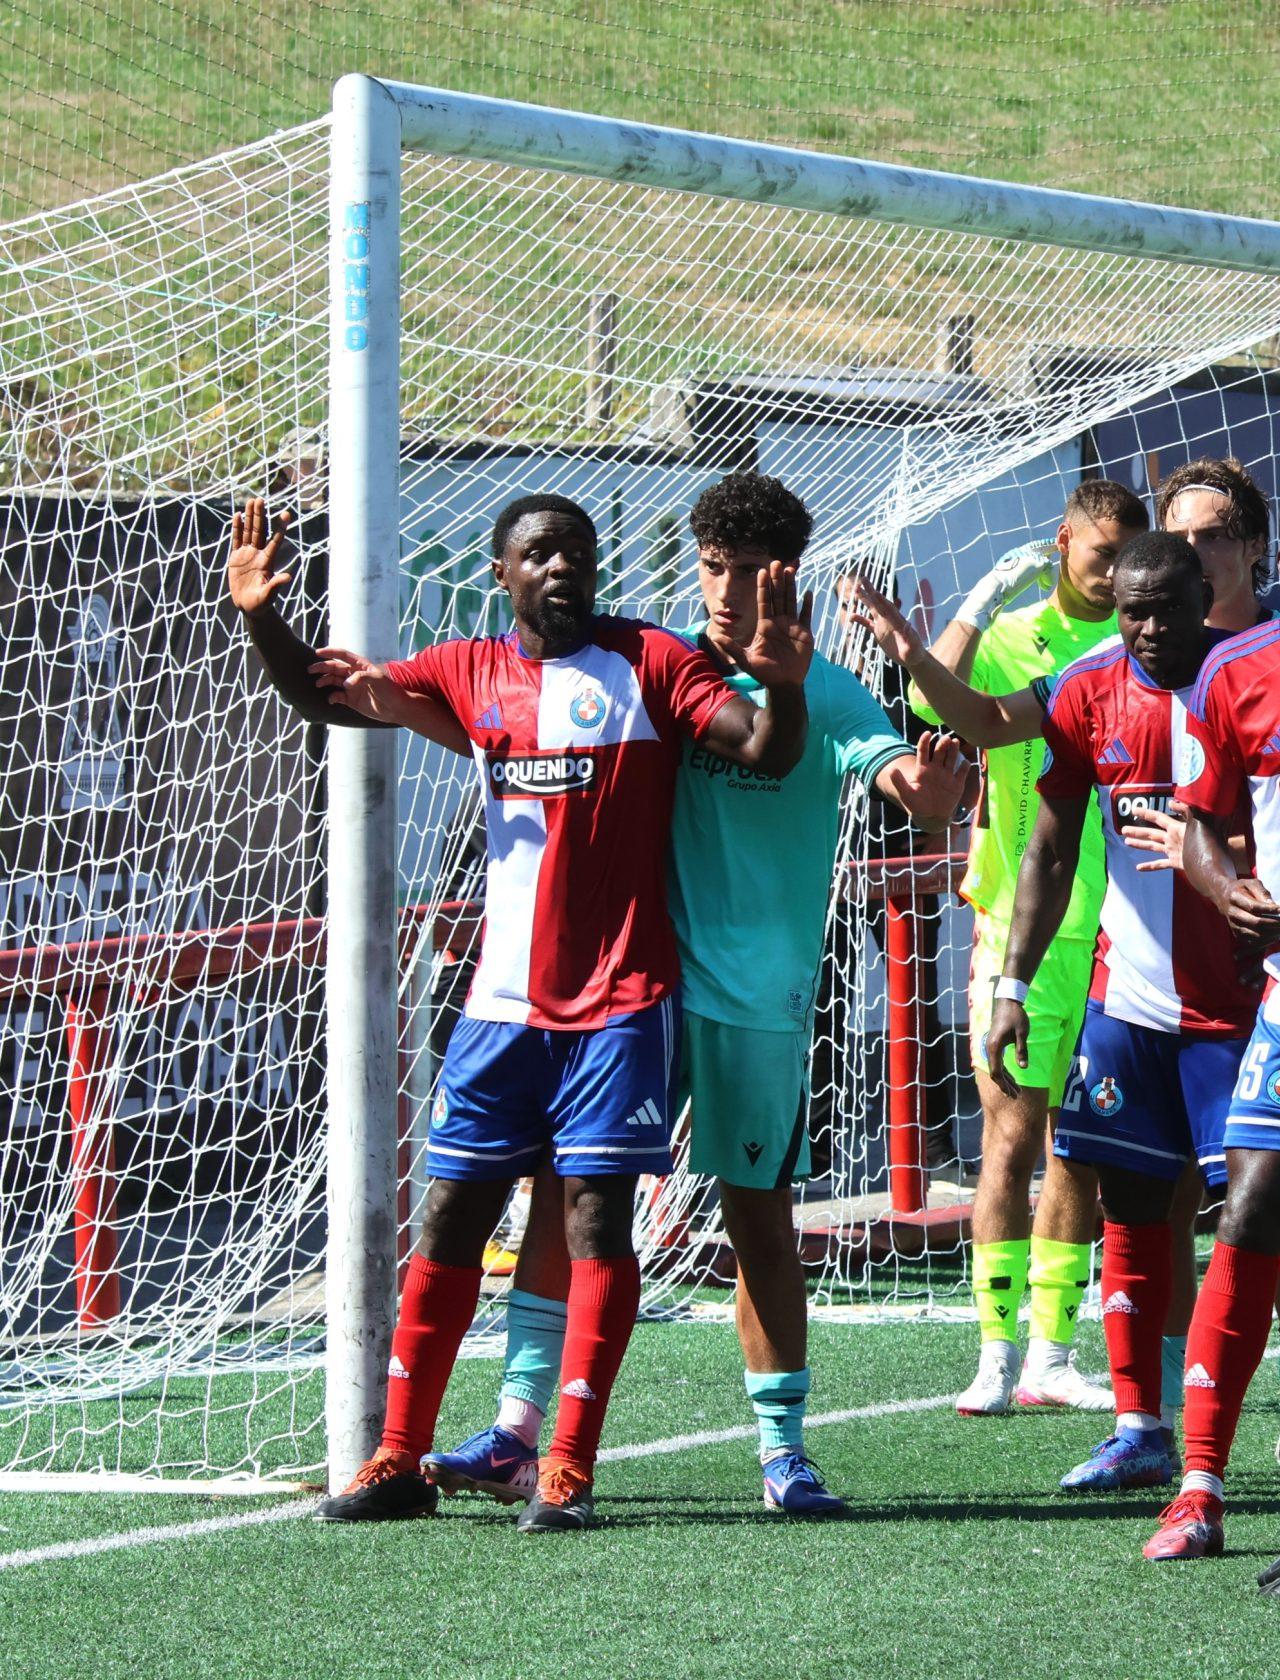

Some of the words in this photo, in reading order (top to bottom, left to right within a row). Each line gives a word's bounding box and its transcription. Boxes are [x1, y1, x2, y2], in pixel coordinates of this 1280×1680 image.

[492, 757, 595, 793] OQUENDO
[727, 779, 757, 792] Grupo
[1017, 799, 1028, 836] DAVID
